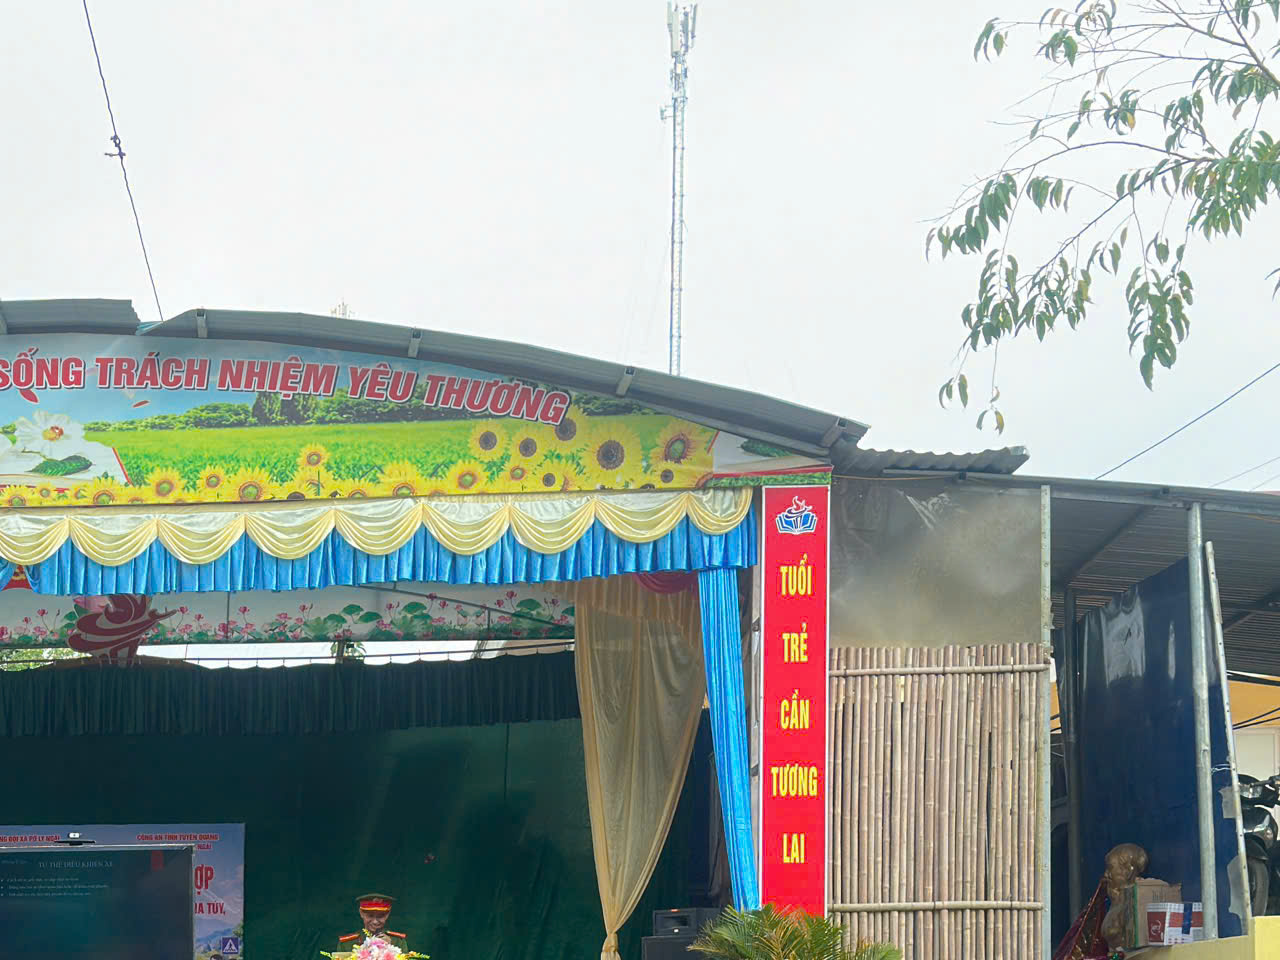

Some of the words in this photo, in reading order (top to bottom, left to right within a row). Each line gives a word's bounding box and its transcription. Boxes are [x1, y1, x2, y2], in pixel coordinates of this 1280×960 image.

[94, 351, 208, 390] TRÁCH
[217, 355, 336, 400] NHIỆM
[348, 362, 415, 403] YÊU
[423, 375, 570, 426] THƯƠNG
[779, 553, 812, 596] TUỔI
[782, 622, 809, 663] TRẺ
[770, 763, 818, 797] TƯƠNG
[782, 833, 805, 864] LAI
[194, 864, 215, 895] ỢP
